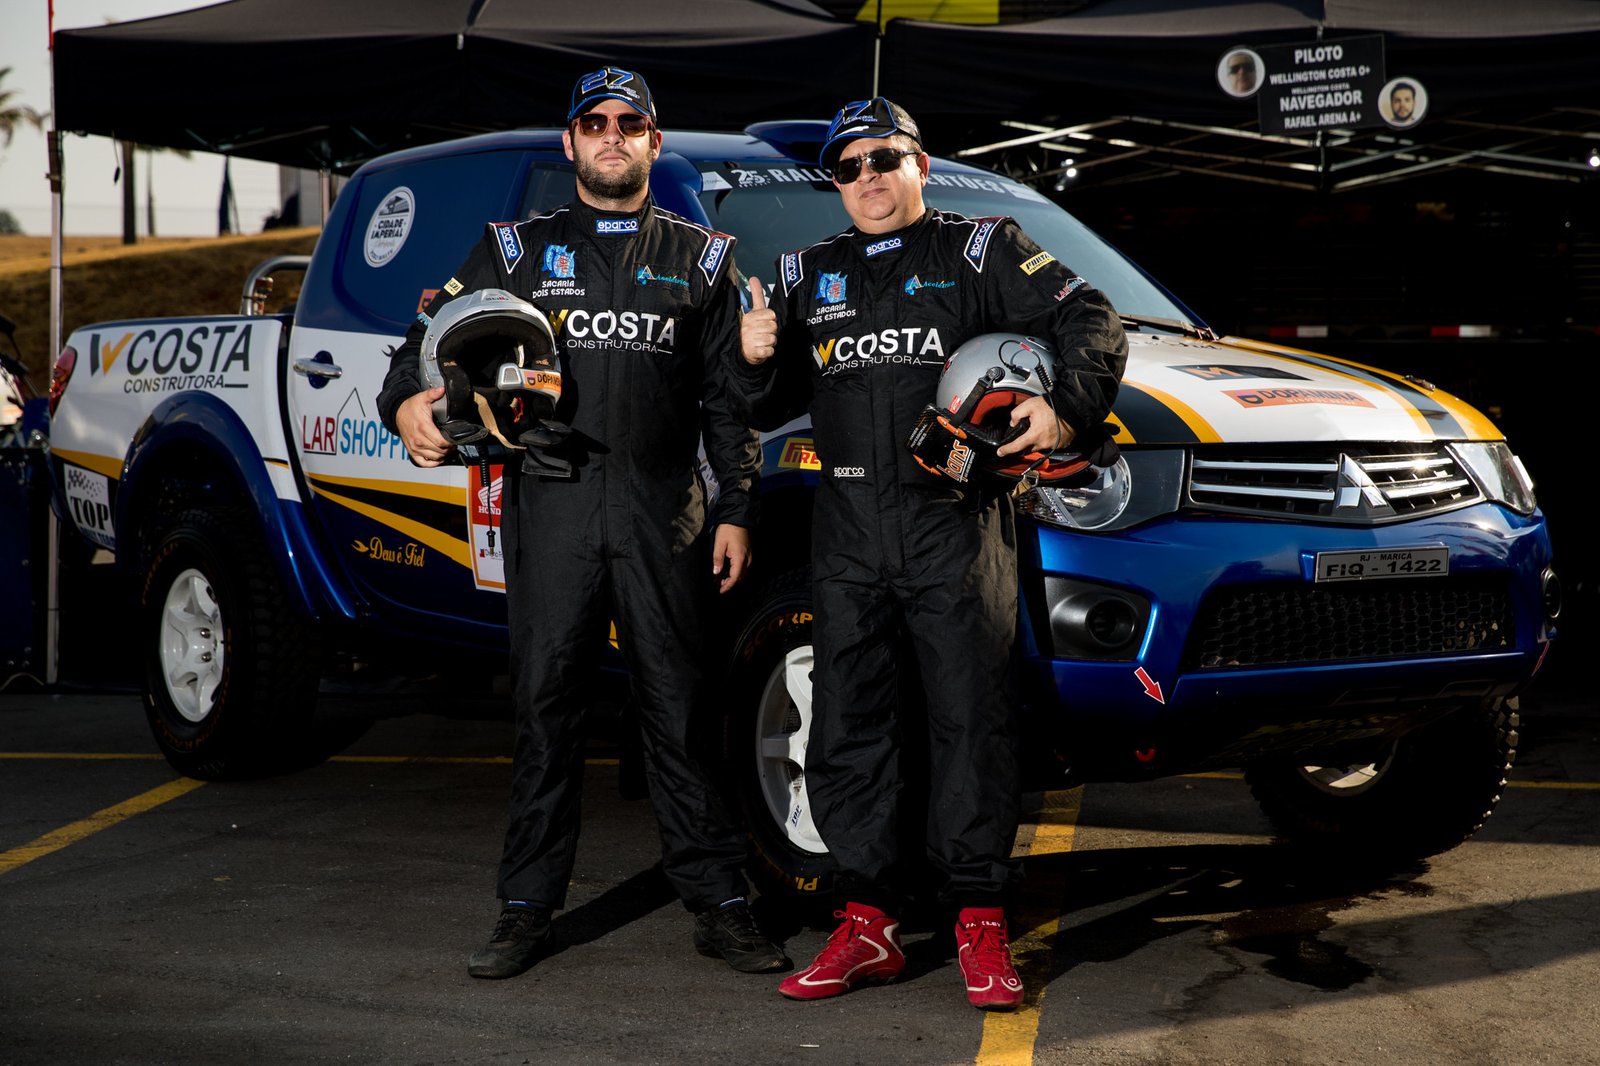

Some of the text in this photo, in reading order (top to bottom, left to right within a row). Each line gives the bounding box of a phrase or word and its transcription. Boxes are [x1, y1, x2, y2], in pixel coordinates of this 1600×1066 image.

[1294, 45, 1343, 64] PILOTO
[581, 67, 634, 94] 27
[1269, 69, 1326, 85] WELLINGTON
[1327, 66, 1357, 79] COSTA
[1291, 83, 1350, 95] WELLINGTON COSTA
[1279, 90, 1362, 112] NAVEGADOR
[1284, 115, 1317, 129] RAFAEL
[1318, 113, 1348, 126] ARENA
[377, 218, 404, 229] CIDADE
[370, 228, 403, 239] IMPERIAL
[541, 280, 575, 288] SACARIA
[532, 288, 586, 298] DOIS ESTADOS
[815, 302, 847, 315] SACARIA
[806, 309, 857, 326] DOIS ESTADOS
[827, 355, 922, 375] CONSTRUTORA
[123, 374, 225, 394] CONSTRUTORA
[1261, 389, 1363, 402] DOPAMINA
[303, 415, 336, 453] LAR
[70, 495, 109, 532] TOP
[369, 536, 395, 562] Deus
[404, 542, 426, 567] Fiel
[1386, 559, 1441, 573] 1422
